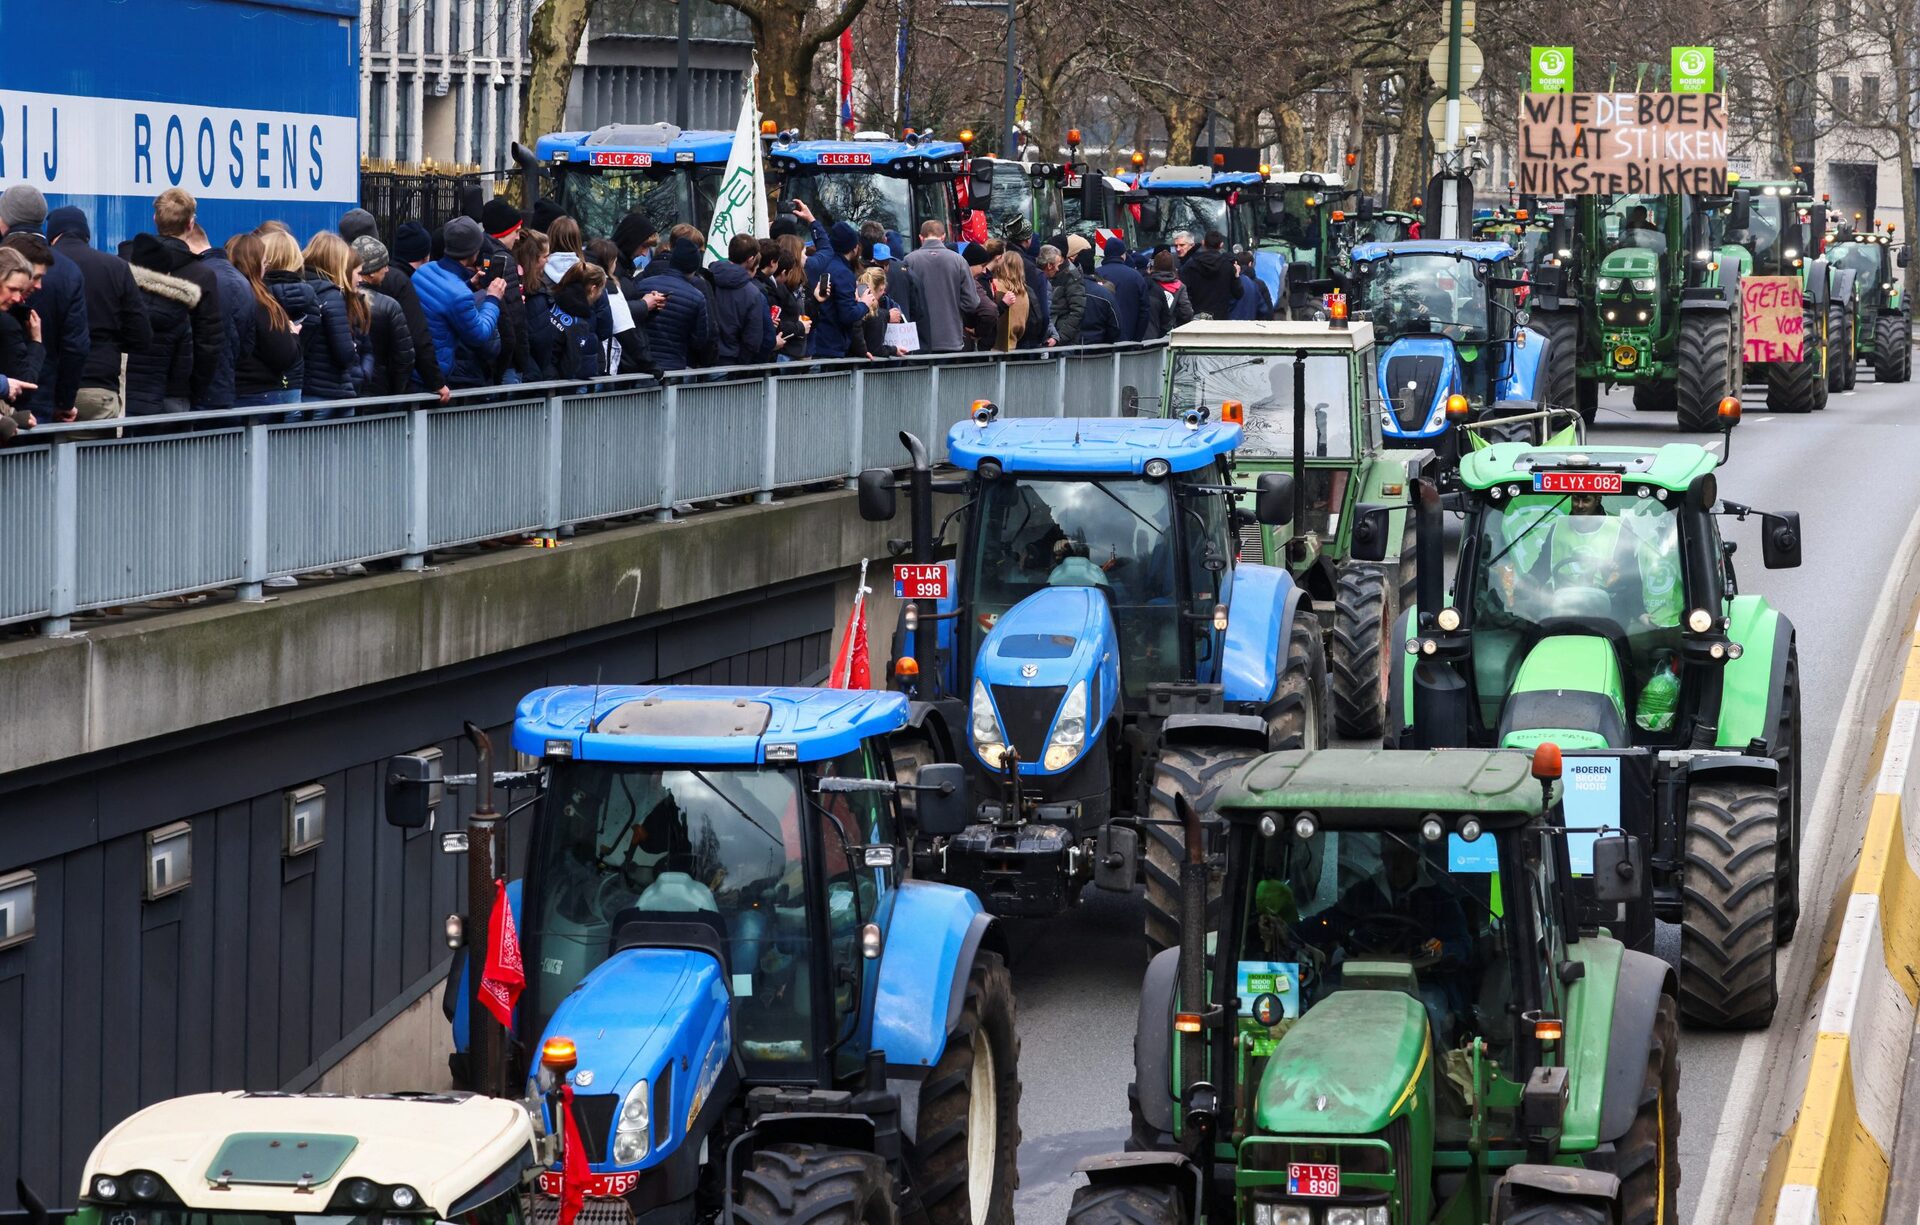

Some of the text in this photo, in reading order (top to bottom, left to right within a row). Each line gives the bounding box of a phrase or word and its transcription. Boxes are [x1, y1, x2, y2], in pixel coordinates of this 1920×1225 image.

[1596, 94, 1636, 126] DE
[1638, 95, 1723, 129] BOER
[0, 104, 323, 191] IJ ROOSENS
[1523, 125, 1611, 160] LAAT
[596, 154, 651, 165] G-LCT-280
[822, 155, 870, 164] G-LCR-814
[1521, 162, 1589, 195] NIKS
[1590, 171, 1623, 195] TE
[1742, 281, 1803, 314] GETEN
[1543, 476, 1619, 490] G-LYX-082
[900, 567, 941, 580] G-LAR
[917, 583, 941, 596] 998
[1570, 766, 1611, 774] #BOEREN
[1575, 774, 1607, 782] BROOD
[1575, 783, 1607, 791] NODIG
[1291, 1166, 1337, 1179] G-LYS
[1309, 1180, 1337, 1194] 890
